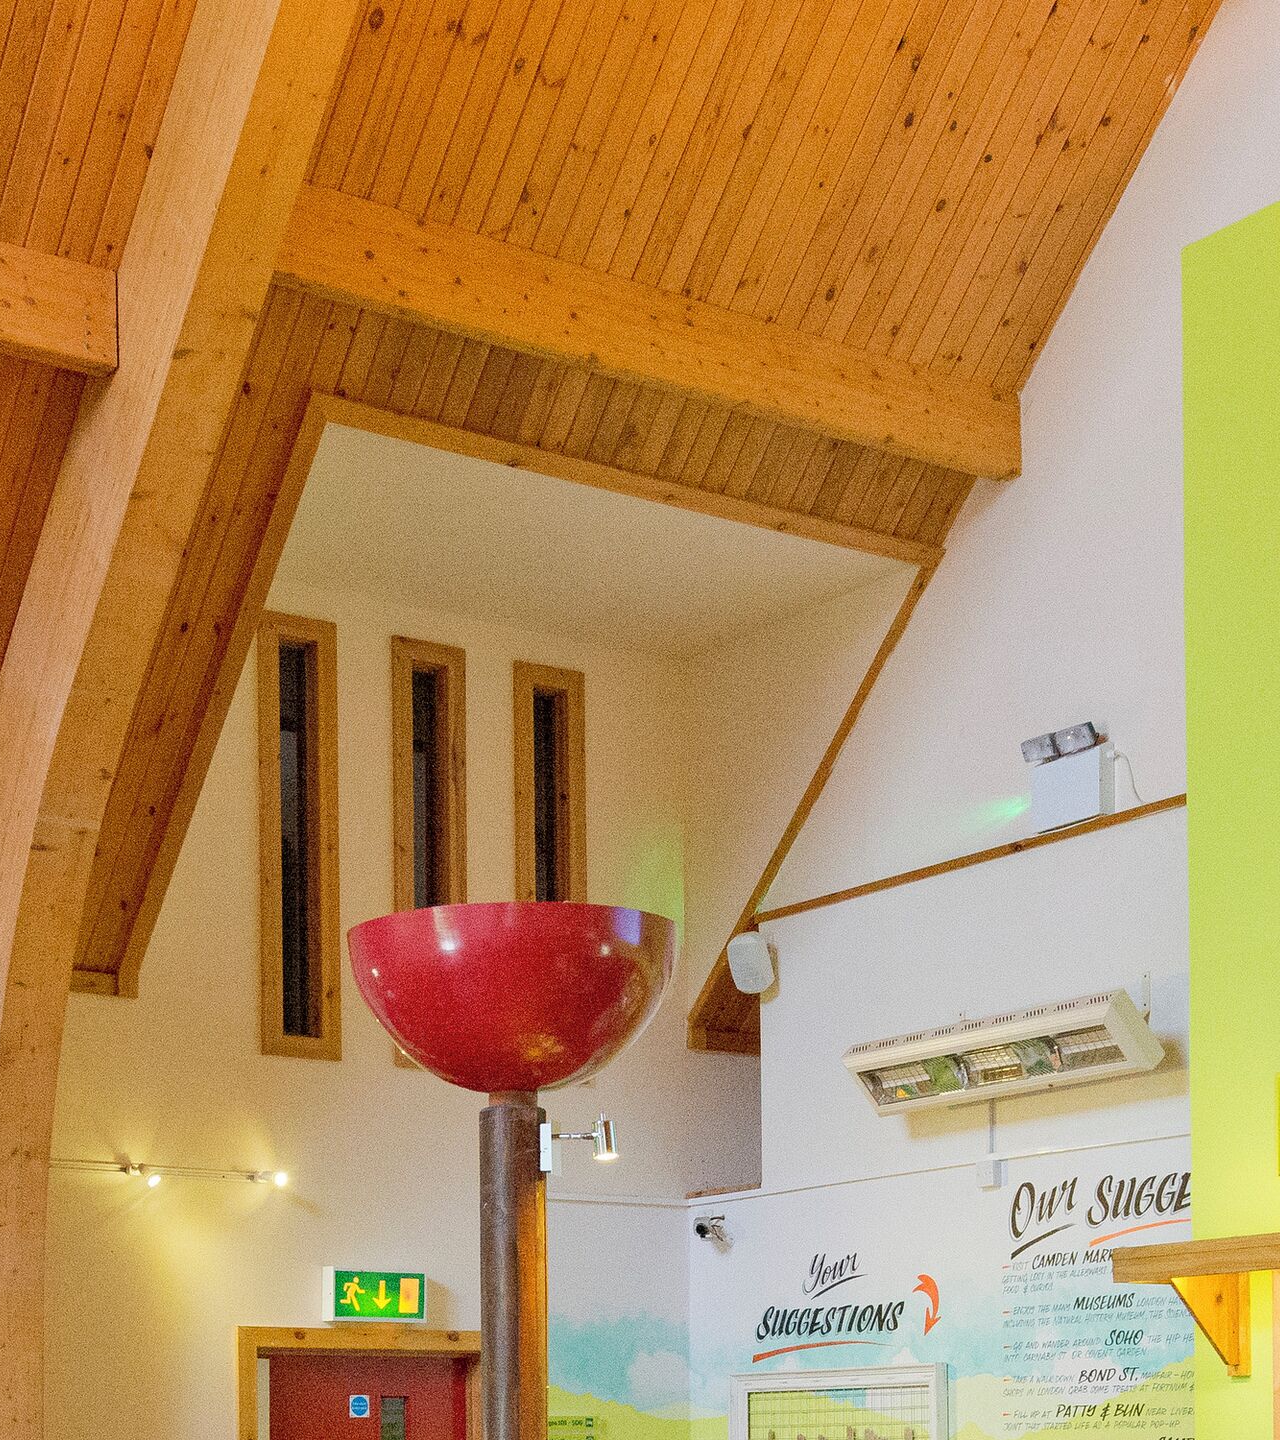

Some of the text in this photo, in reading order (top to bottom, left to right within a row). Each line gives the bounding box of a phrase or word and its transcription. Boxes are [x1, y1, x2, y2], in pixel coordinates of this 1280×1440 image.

[1010, 1174, 1079, 1241] Our
[1032, 1252, 1077, 1270] CAMDEN
[804, 1251, 863, 1294] Your
[1073, 1293, 1136, 1311] MUSEUMS
[755, 1299, 906, 1342] SUGGESTIONS
[1105, 1329, 1144, 1346] SOHO
[1148, 1335, 1162, 1343] THE
[1166, 1333, 1180, 1343] HIP
[1079, 1367, 1138, 1384] BOND ST.
[1056, 1403, 1145, 1421] PATTY & BUN
